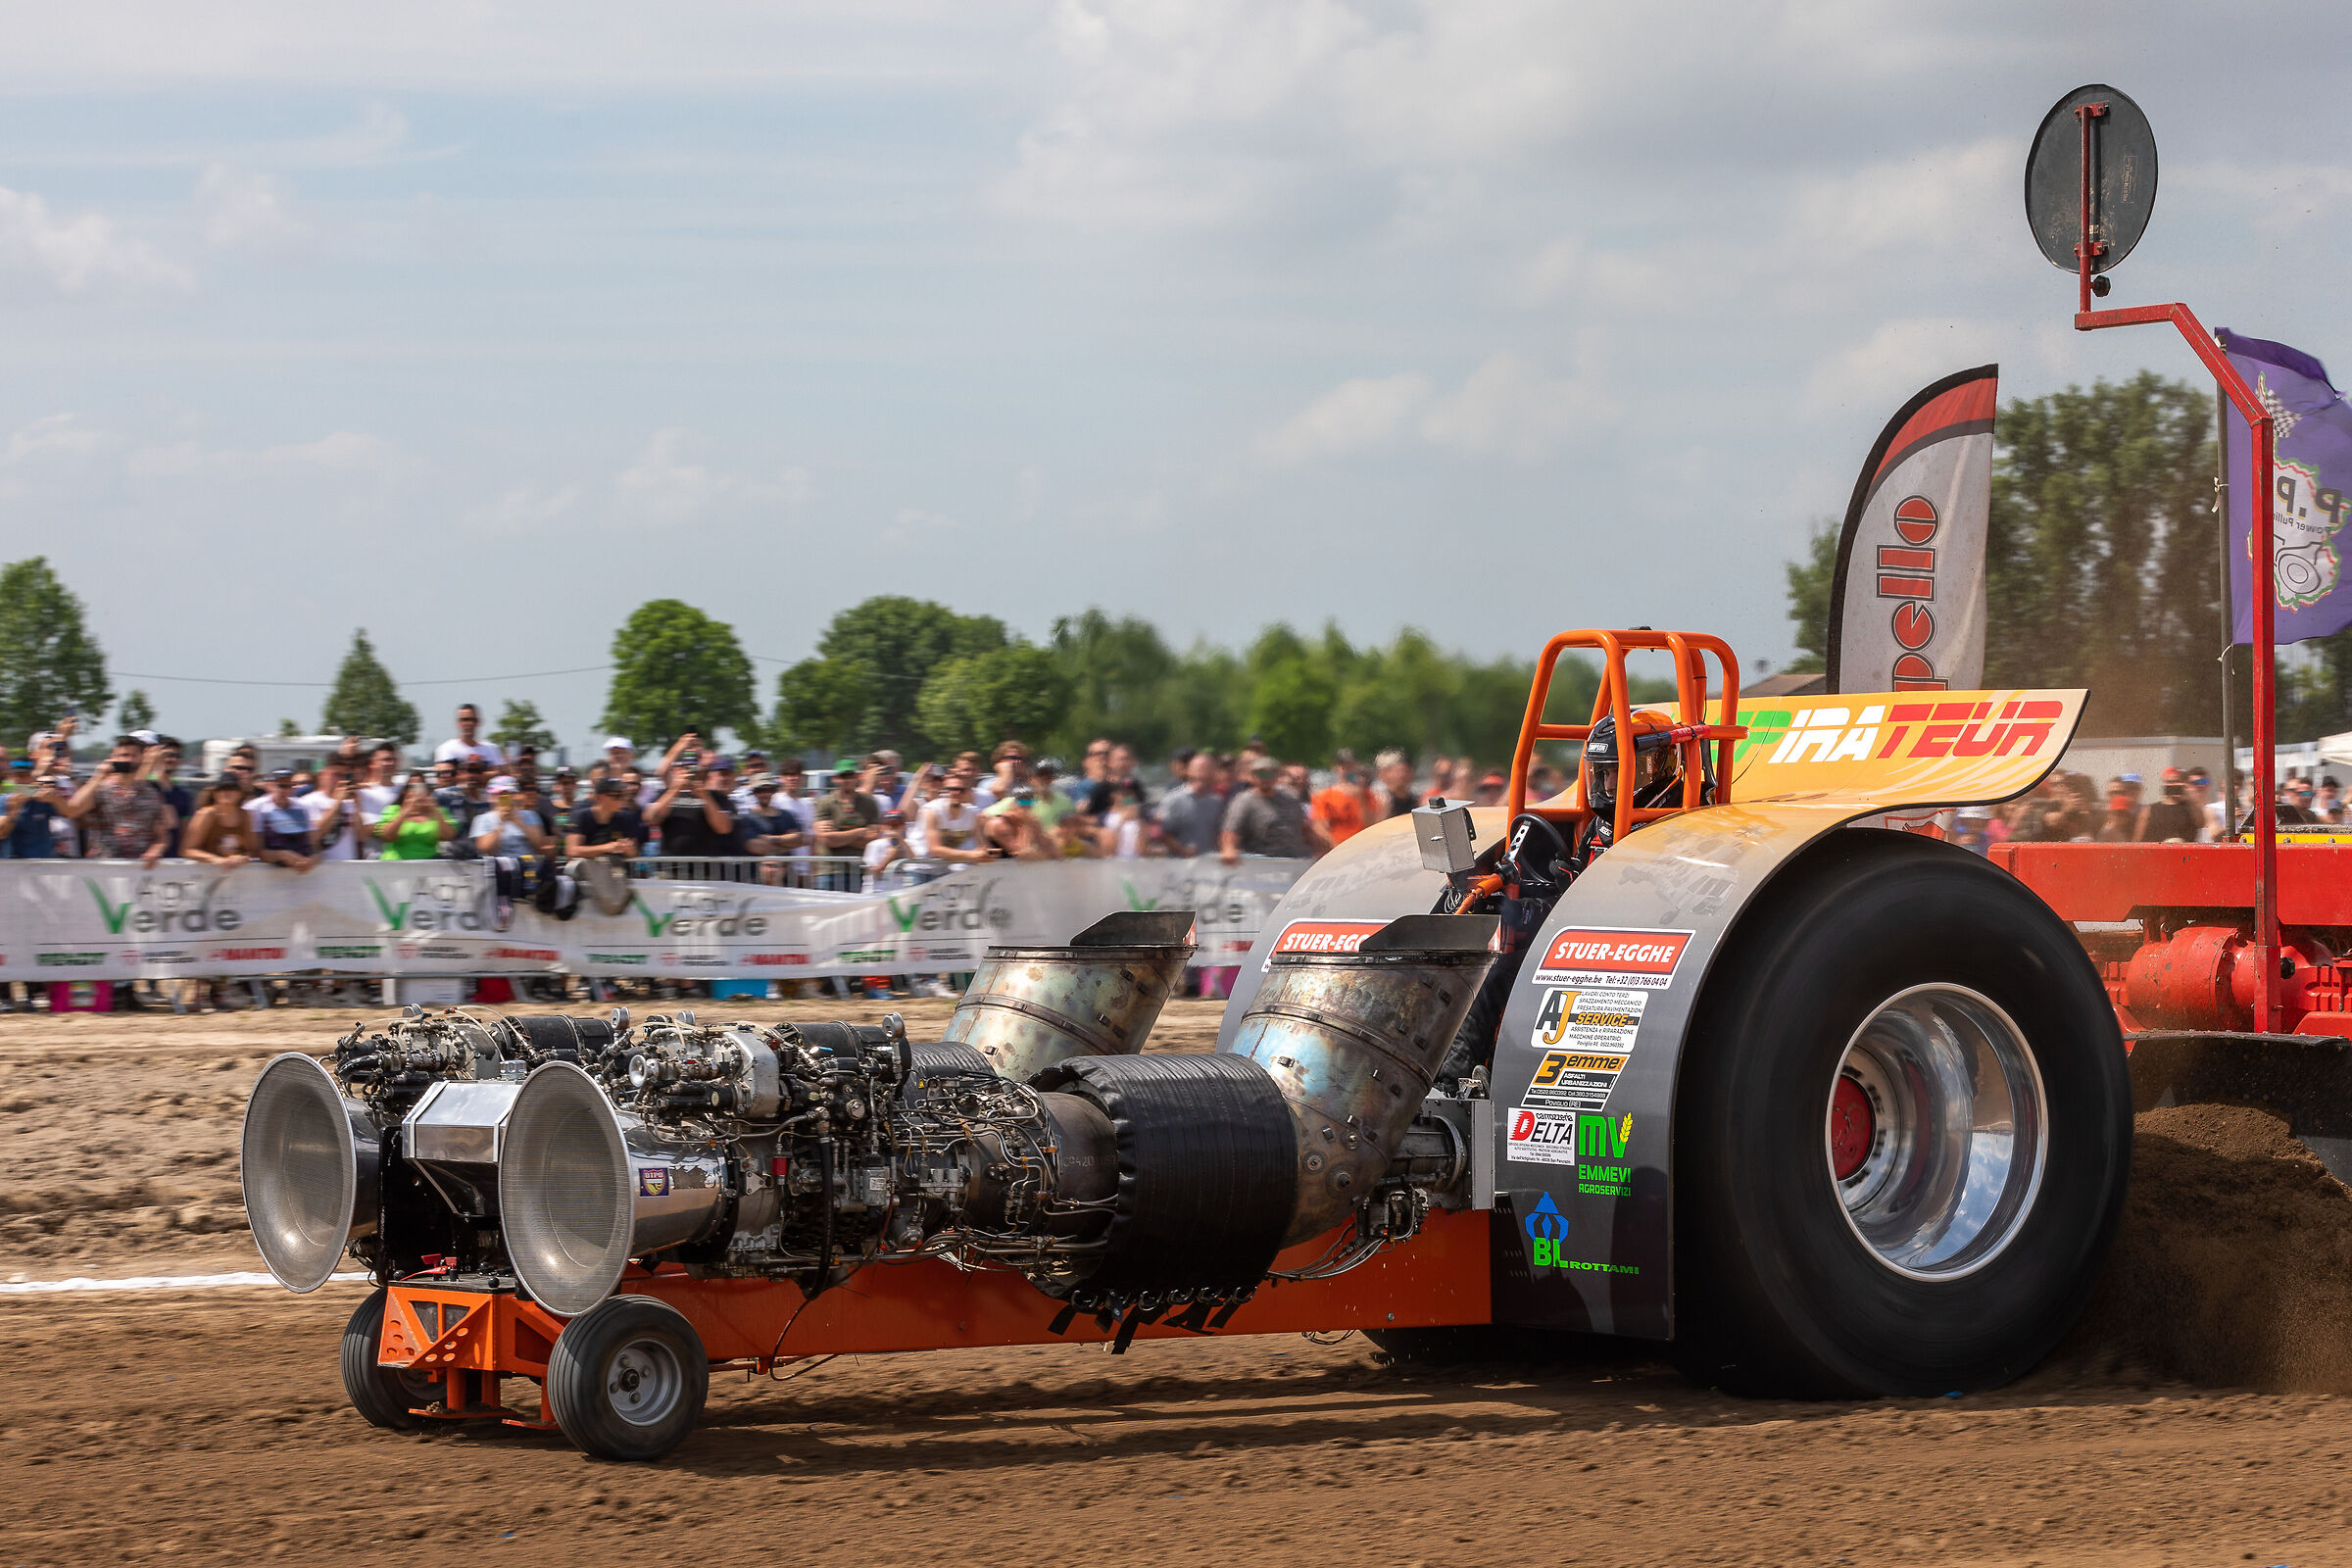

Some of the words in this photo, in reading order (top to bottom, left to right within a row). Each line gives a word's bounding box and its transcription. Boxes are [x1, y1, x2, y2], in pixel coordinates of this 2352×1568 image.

[1877, 495, 1948, 692] pello
[1670, 701, 2064, 764] PIRATEUR
[81, 876, 242, 934] Verde
[364, 876, 497, 931] Verd
[631, 889, 766, 937] Verde
[1554, 942, 1676, 962] STUER-EGGHE
[1535, 974, 1602, 985] www.stuer-egghe.be
[1575, 1012, 1630, 1027] SERVICE
[1509, 1110, 1573, 1145] DELTA
[1579, 1164, 1631, 1183] EMMEVI
[1579, 1183, 1631, 1197] AGROSERVIZI
[1534, 1237, 1568, 1268] BL
[1569, 1261, 1639, 1274] ROTTAMI
